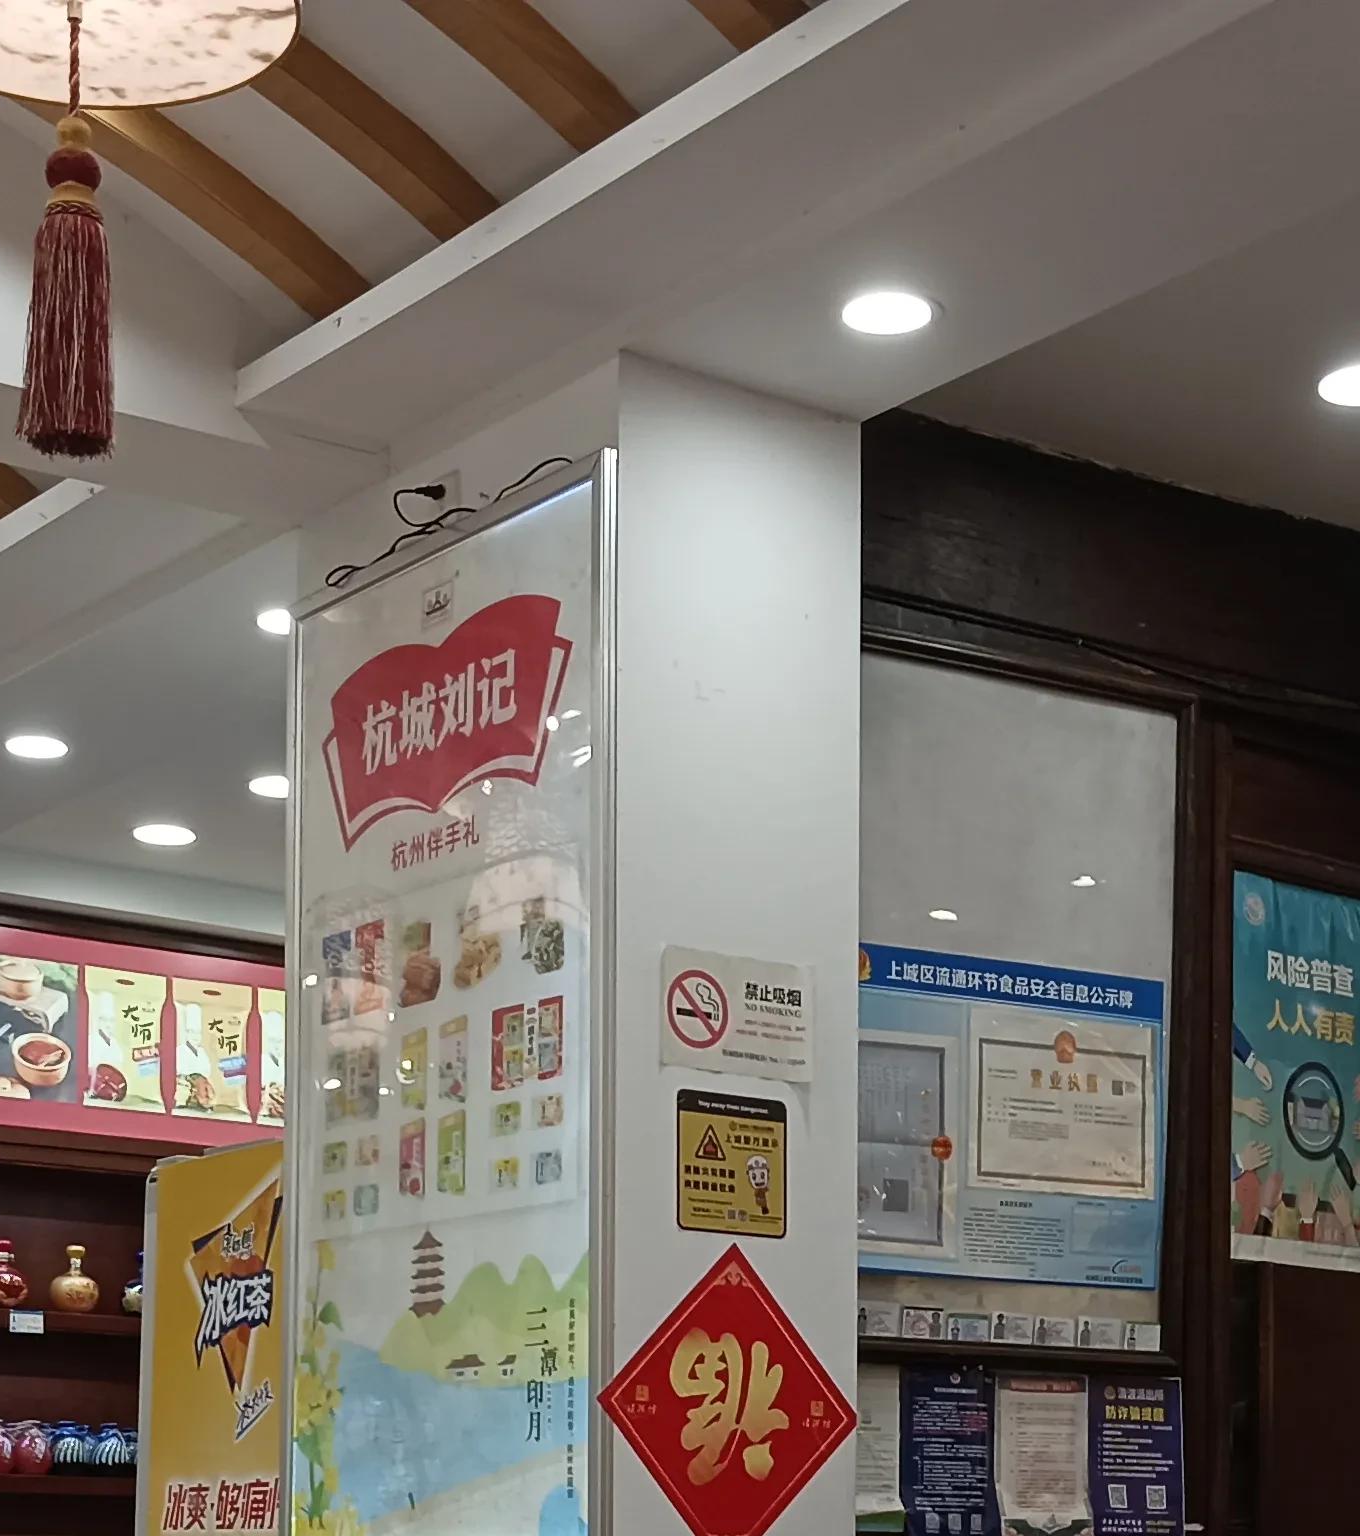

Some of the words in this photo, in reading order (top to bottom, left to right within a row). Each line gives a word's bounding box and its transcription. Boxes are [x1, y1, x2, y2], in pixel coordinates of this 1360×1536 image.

[361, 650, 516, 776] 杭城刘记
[390, 817, 481, 872] 杭州伴手礼
[744, 982, 801, 1007] 禁止吸烟
[886, 960, 1133, 1009] 上城区流通环节食品安全信息公示牌
[1266, 950, 1354, 998] 风险普查
[744, 1003, 757, 1011] NO
[759, 1004, 801, 1017] SMOKING
[1267, 1002, 1355, 1046] 人人有责
[199, 1275, 271, 1336] 冰红茶
[524, 1306, 559, 1442] 三潭印月
[669, 1326, 790, 1487] 福
